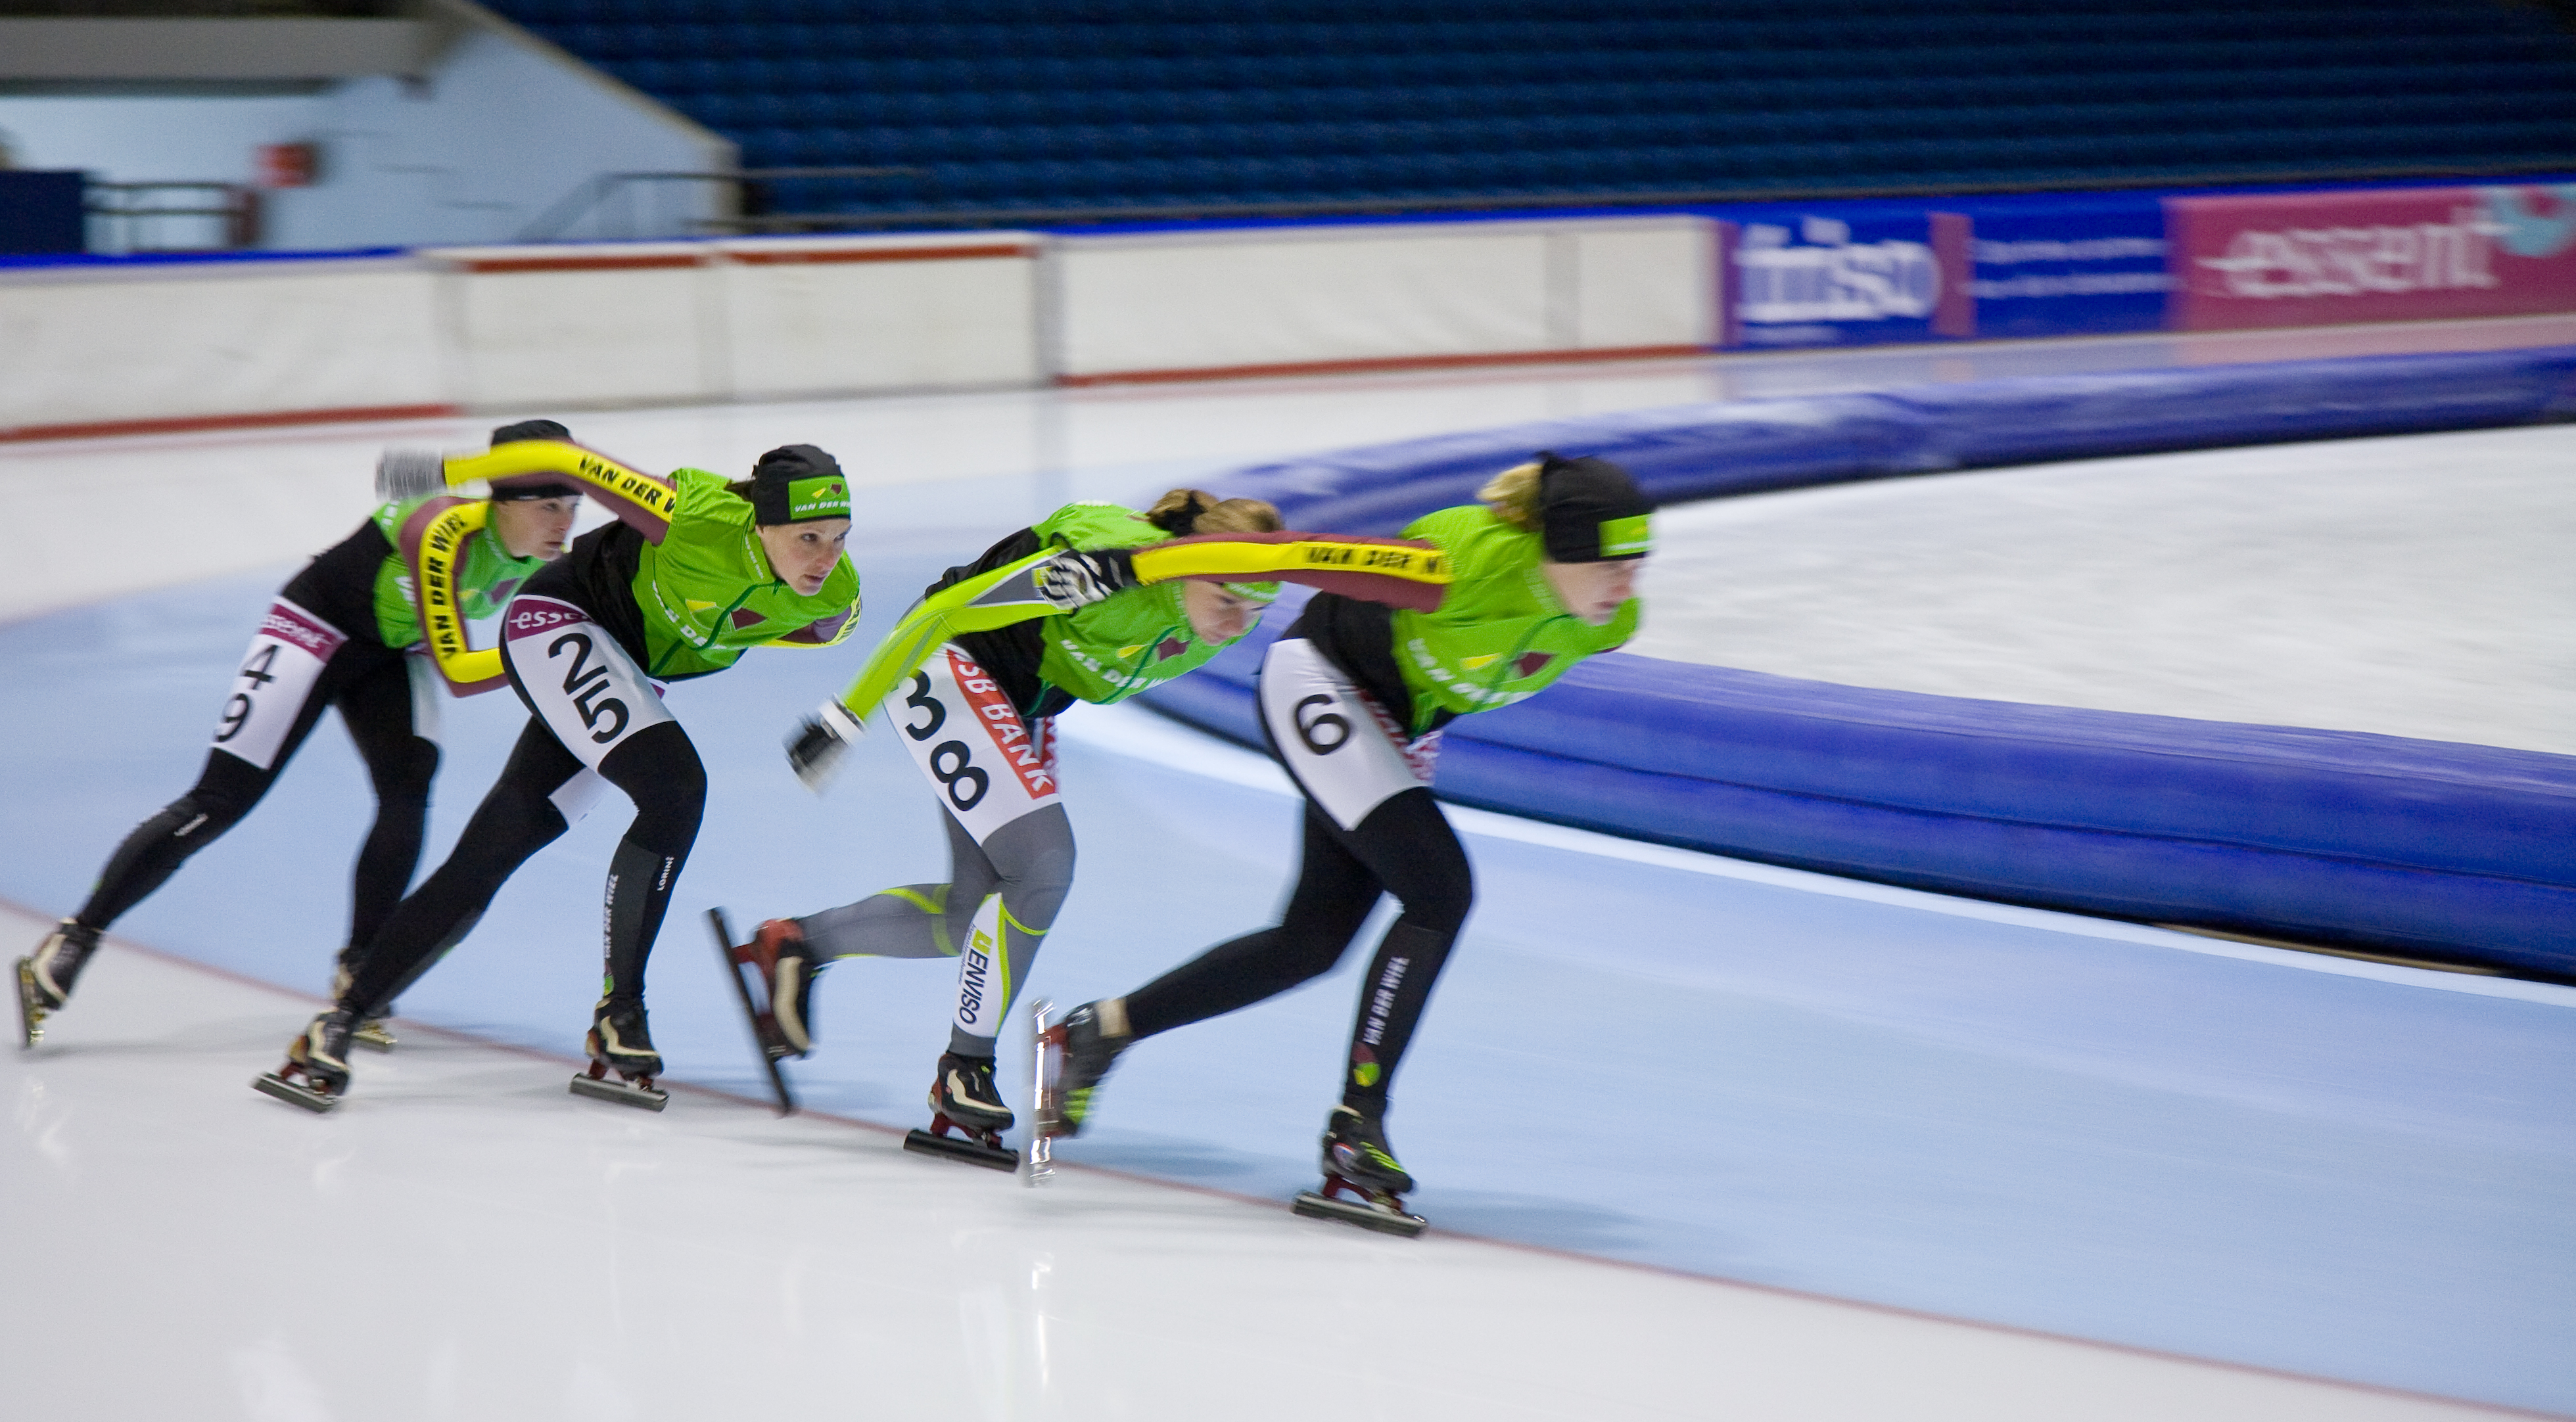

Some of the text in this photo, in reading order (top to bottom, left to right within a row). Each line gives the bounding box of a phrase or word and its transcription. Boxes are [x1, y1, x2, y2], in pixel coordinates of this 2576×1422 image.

[580, 455, 619, 484] VAN
[621, 474, 662, 506] DER
[794, 503, 816, 513] VAN
[818, 501, 839, 509] DER
[427, 557, 448, 607] DER
[548, 632, 630, 744] 25
[904, 668, 990, 812] 38
[954, 653, 1054, 792] SB BANK
[1293, 693, 1353, 756] 6
[959, 948, 989, 1024] ENVISO
[1371, 988, 1395, 1017] DER
[1363, 1017, 1386, 1045] VAN
